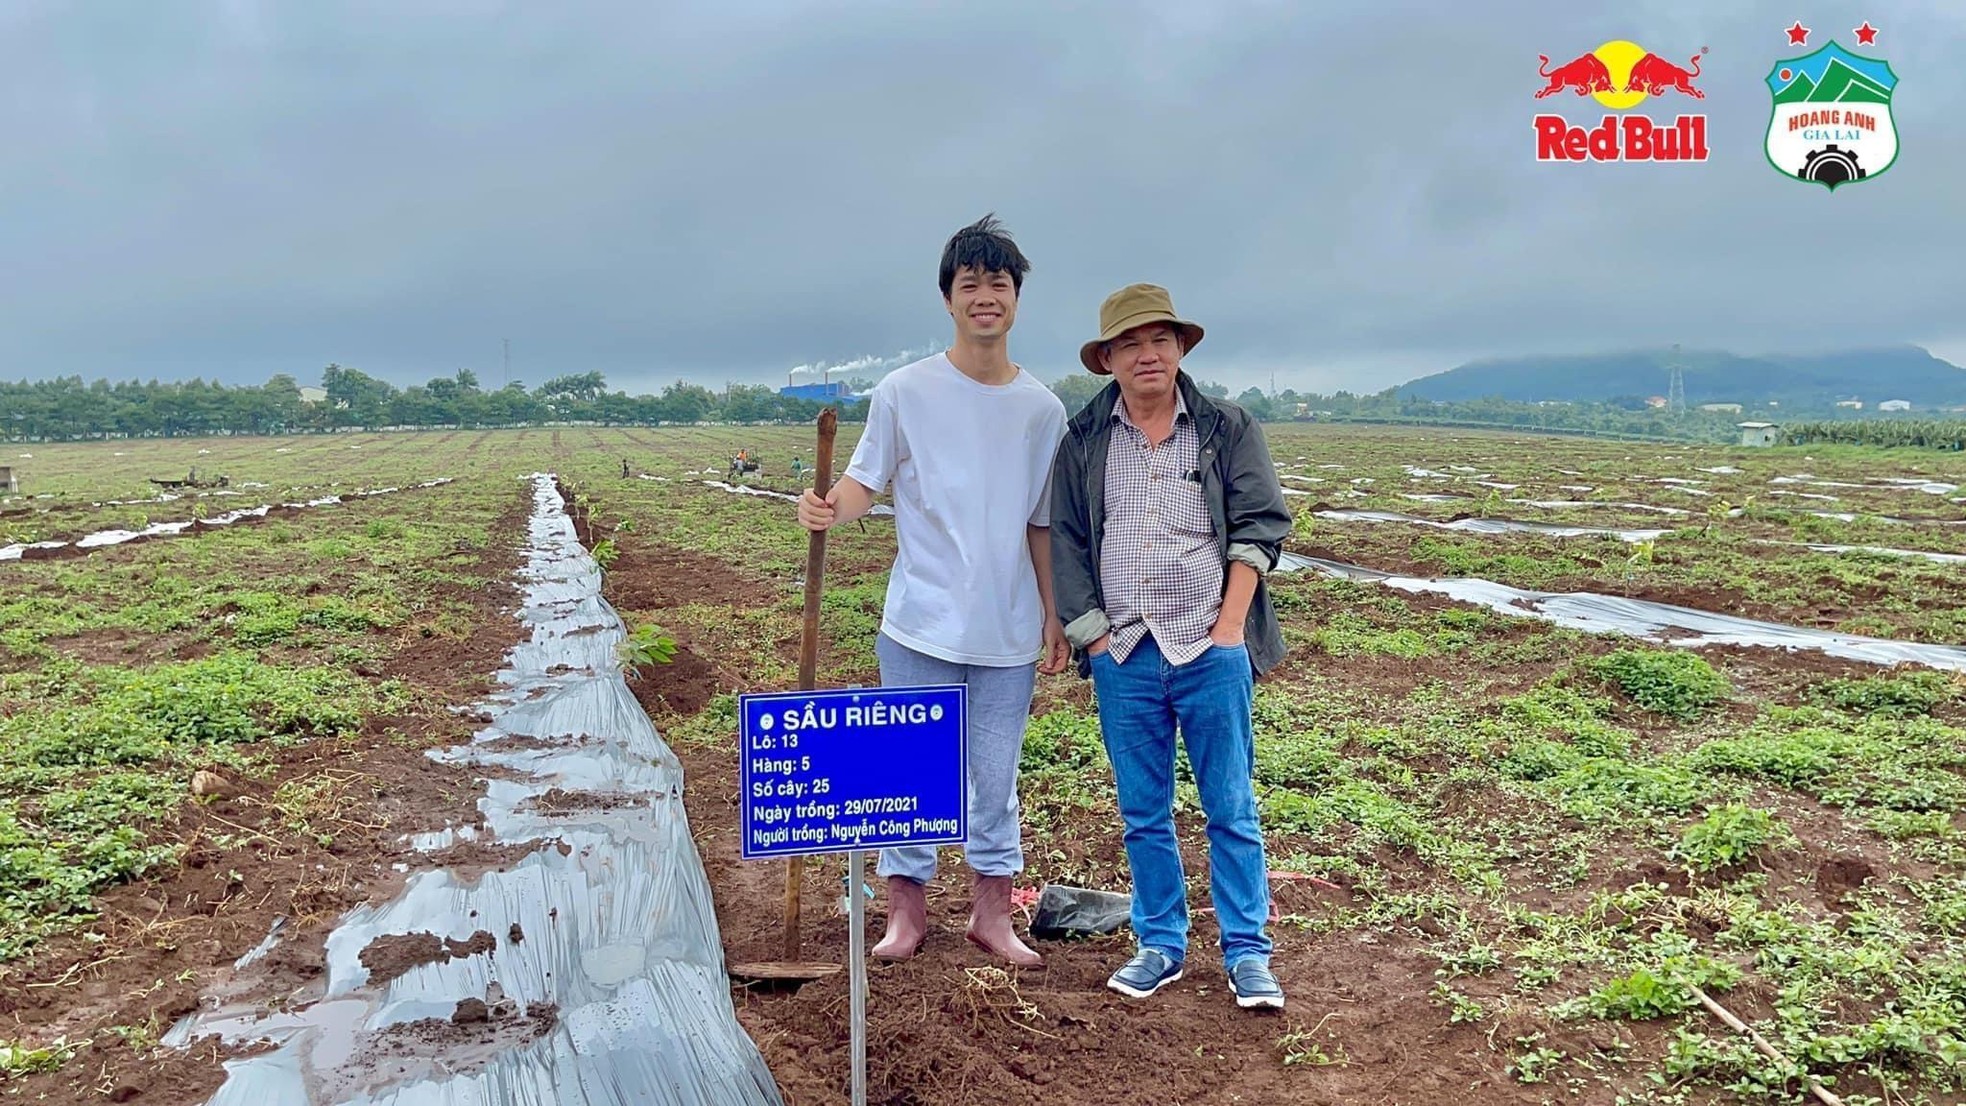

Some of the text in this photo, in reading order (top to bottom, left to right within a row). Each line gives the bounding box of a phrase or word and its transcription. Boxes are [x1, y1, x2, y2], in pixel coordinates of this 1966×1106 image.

[783, 701, 926, 730] SẦU RIÊNG
[753, 734, 798, 749] Lô: 13
[753, 757, 810, 775] Hàng: 5
[753, 779, 829, 798] Số cây: 25
[754, 797, 918, 824] Ngày trồng: 29/07/2021
[754, 818, 958, 846] Người trồng: Nguyễn Công Phượng
